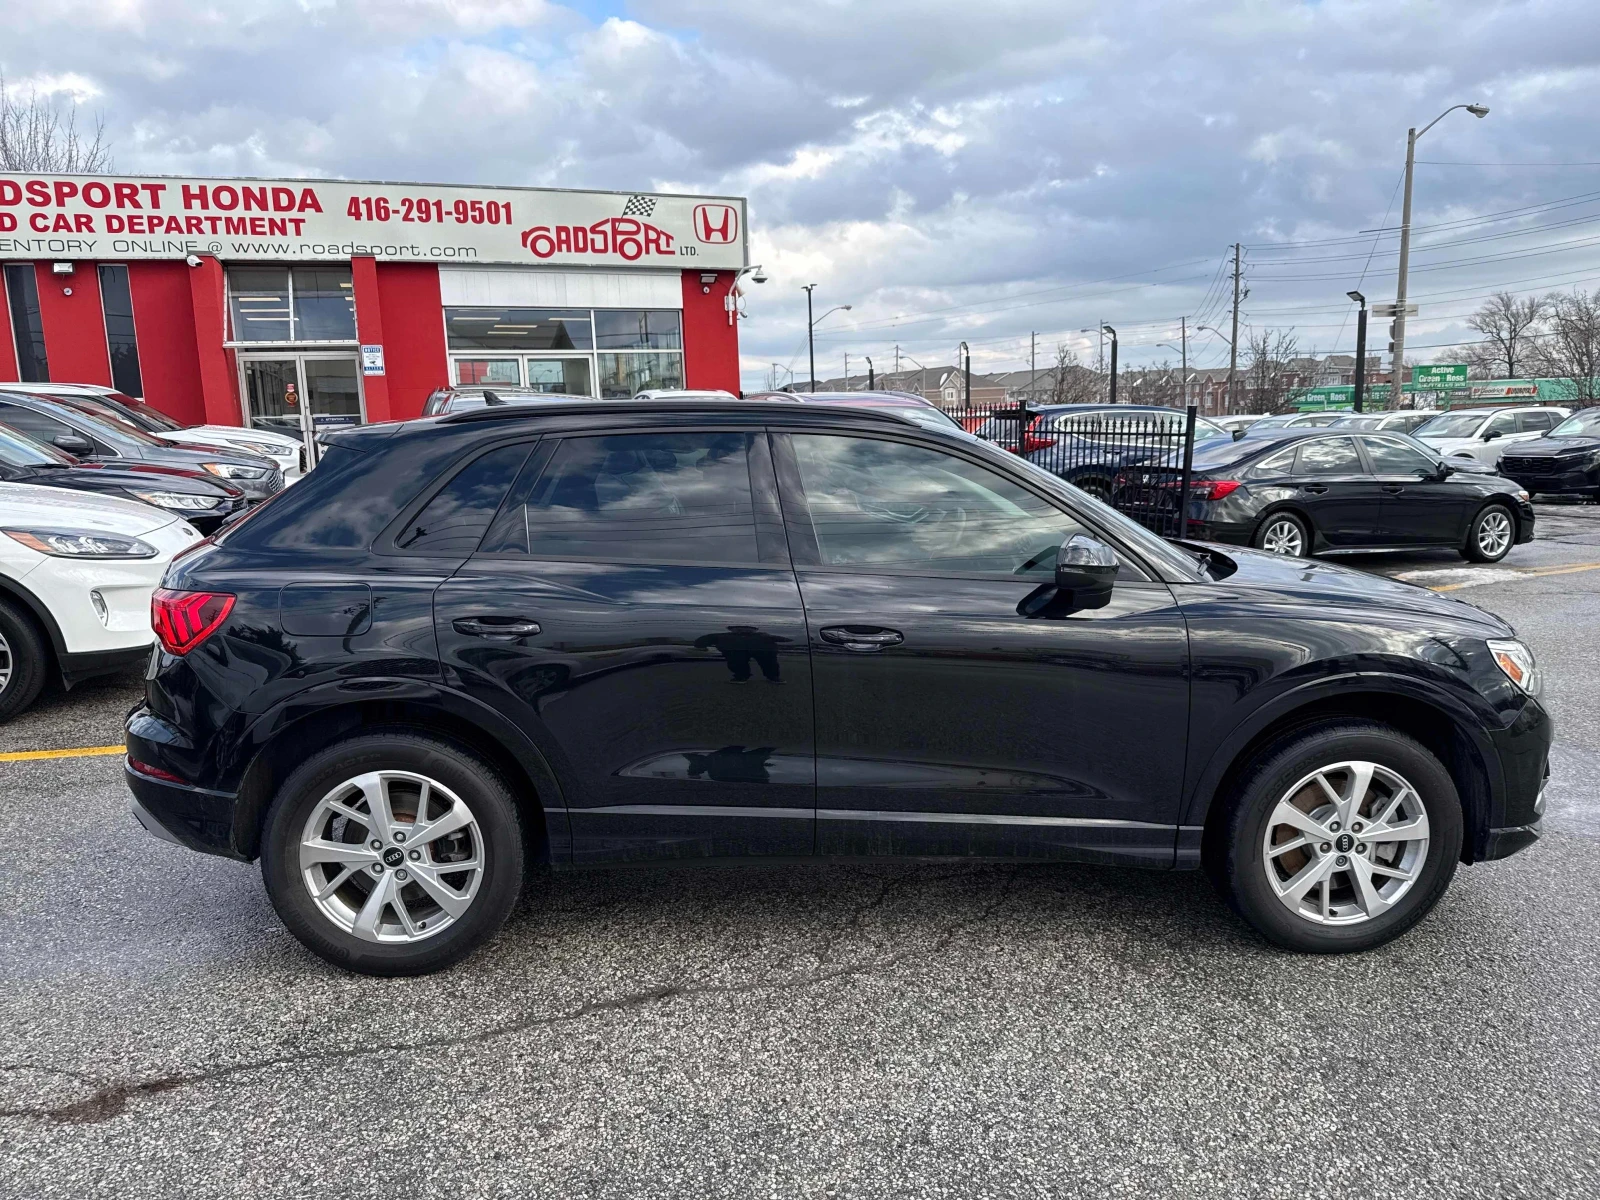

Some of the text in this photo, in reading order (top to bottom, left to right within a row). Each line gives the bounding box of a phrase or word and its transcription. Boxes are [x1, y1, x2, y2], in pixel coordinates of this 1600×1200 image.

[0, 180, 323, 213] DSPORT HONDA
[346, 196, 513, 225] 416-291-9501
[29, 212, 97, 233] CAR
[105, 214, 306, 237] DEPARTMENT
[0, 239, 98, 252] ENTORY
[112, 239, 198, 253] ONLINE
[207, 241, 223, 254] @
[679, 246, 699, 256] LTD.
[1431, 366, 1455, 374] Active
[1418, 375, 1440, 383] Green
[1446, 374, 1465, 382] Ross
[1306, 393, 1326, 402] Green
[1330, 392, 1346, 401] Ross
